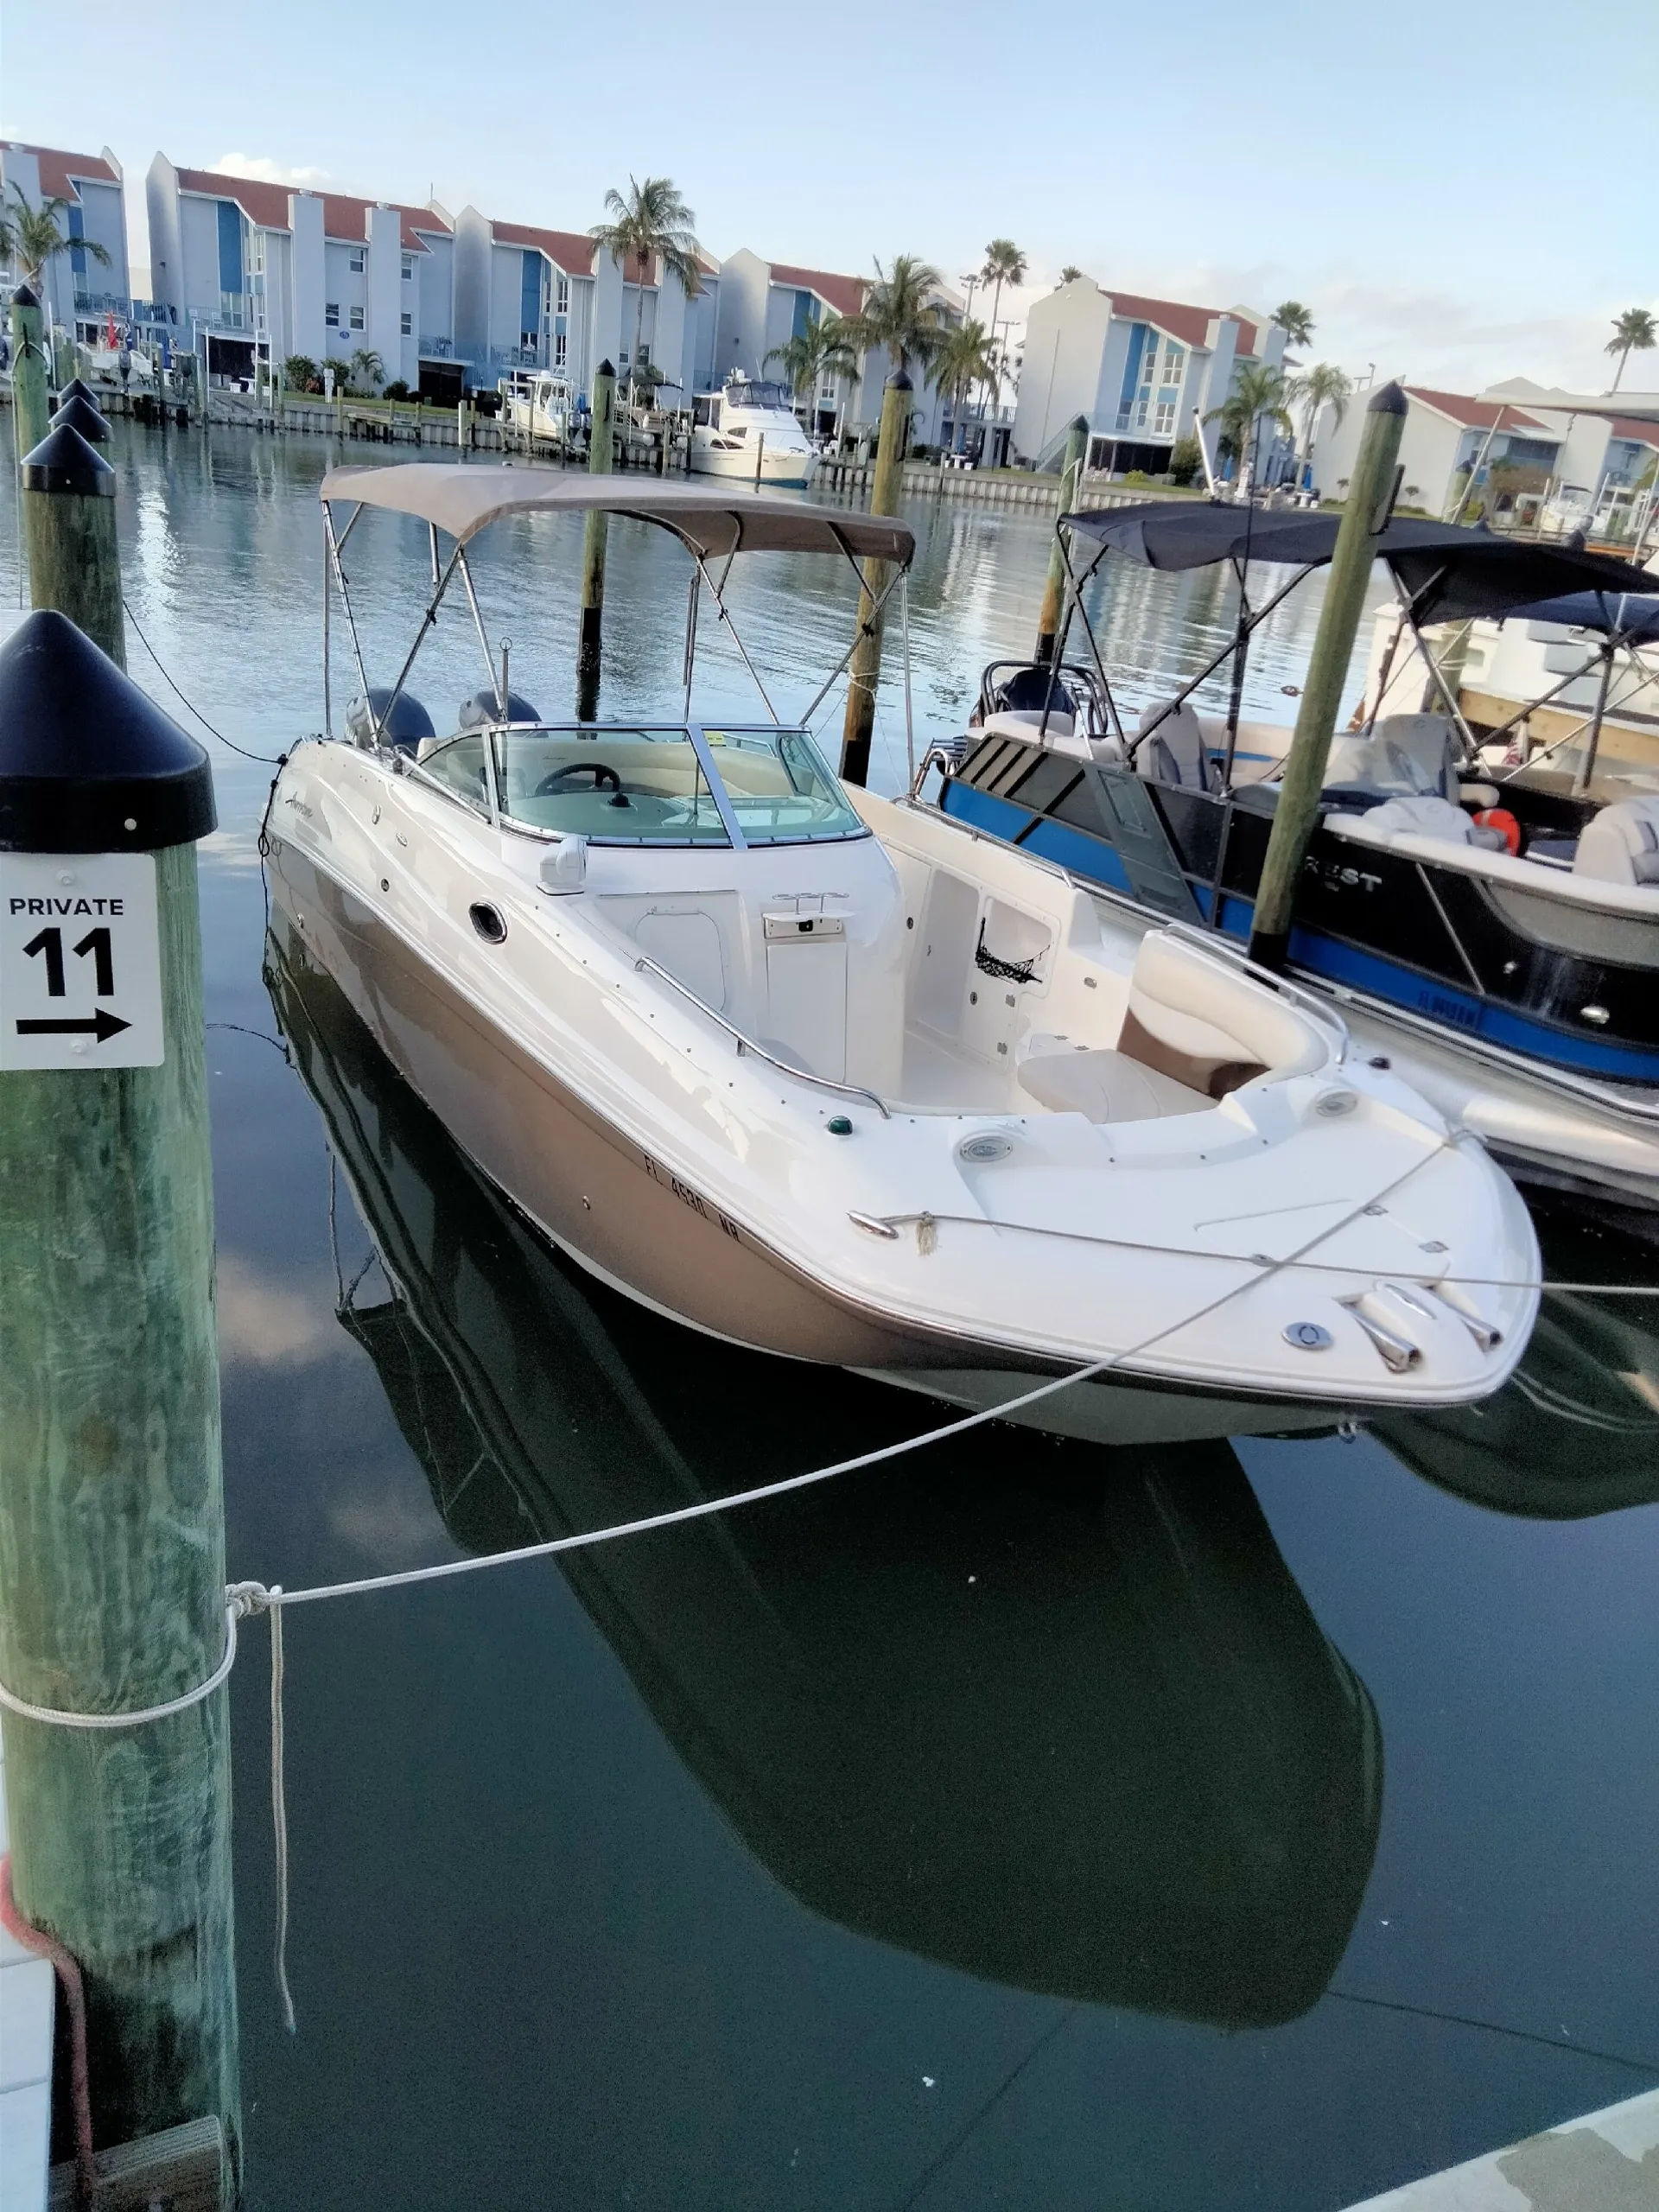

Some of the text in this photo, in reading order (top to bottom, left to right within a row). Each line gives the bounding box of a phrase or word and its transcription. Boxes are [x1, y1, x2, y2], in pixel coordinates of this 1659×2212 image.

[9, 898, 124, 916] PRIVATE
[22, 926, 115, 997] 11
[644, 1154, 664, 1185] FL
